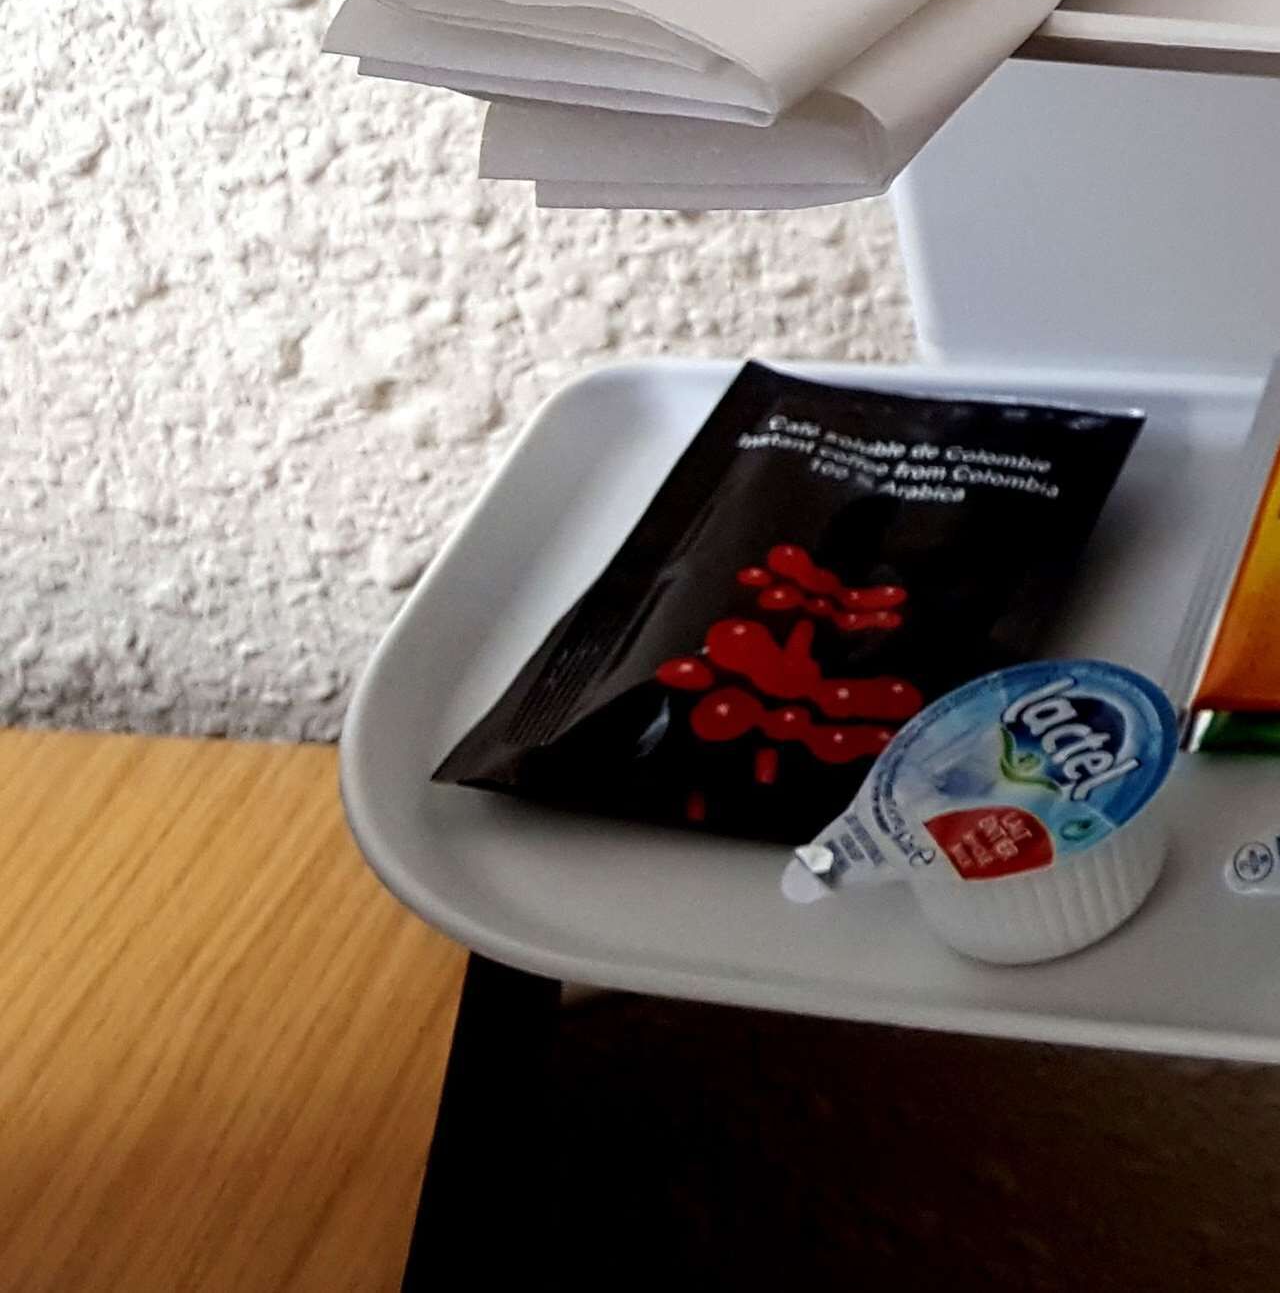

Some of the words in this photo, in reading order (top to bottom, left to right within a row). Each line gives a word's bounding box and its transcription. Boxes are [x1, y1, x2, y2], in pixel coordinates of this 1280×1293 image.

[910, 442, 940, 461] de
[893, 460, 946, 482] from
[951, 463, 1060, 499] Colombia
[876, 480, 966, 503] Arabica
